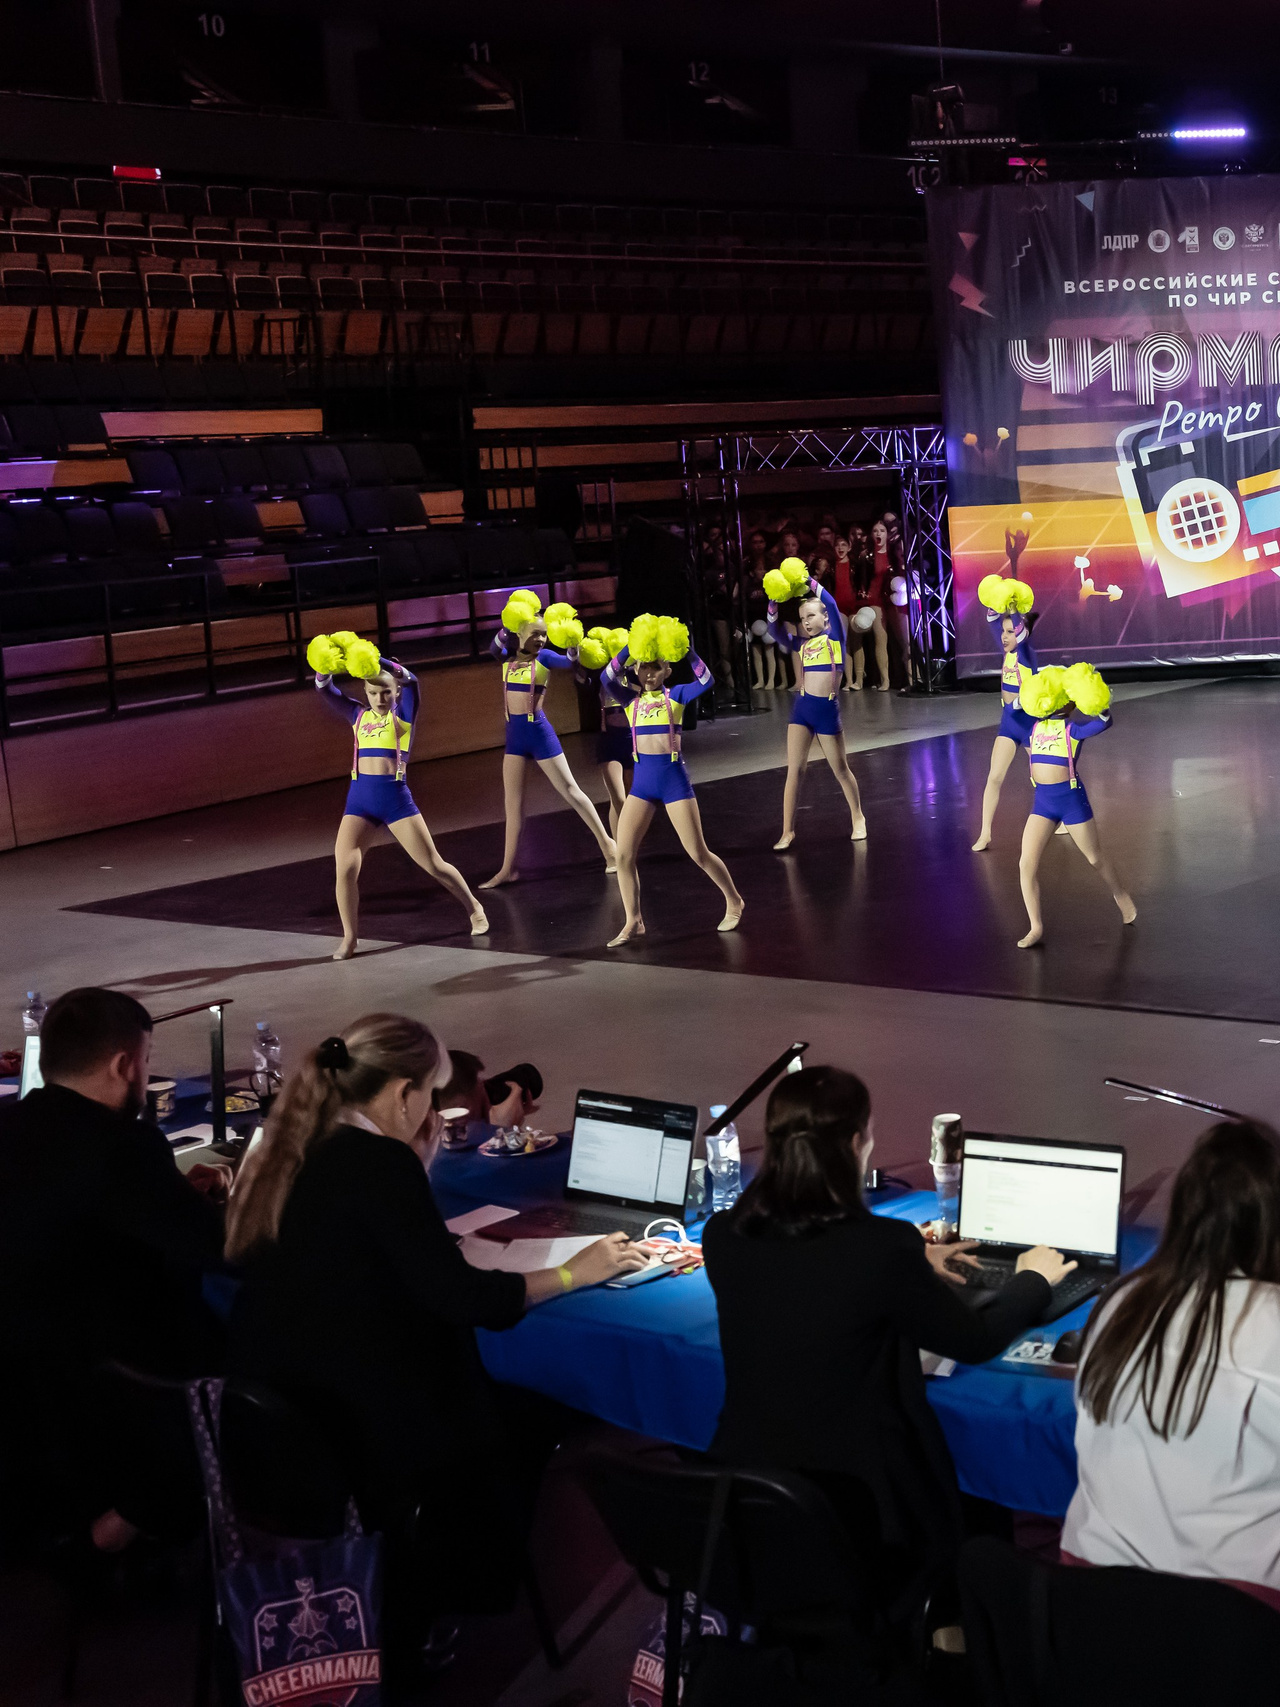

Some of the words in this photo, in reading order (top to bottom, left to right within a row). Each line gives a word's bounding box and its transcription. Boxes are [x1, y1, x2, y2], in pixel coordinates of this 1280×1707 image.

[198, 13, 225, 37] 10
[469, 41, 490, 63] 11
[688, 61, 710, 81] 12
[1102, 234, 1139, 251] ЛДПР
[1064, 272, 1258, 294] ВСЕРОССИЙСКИЕ
[1168, 293, 1198, 308] ПО
[1208, 291, 1252, 306] ЧИР
[1157, 400, 1262, 442] Ретро
[246, 1655, 380, 1706] CHEERMANIA
